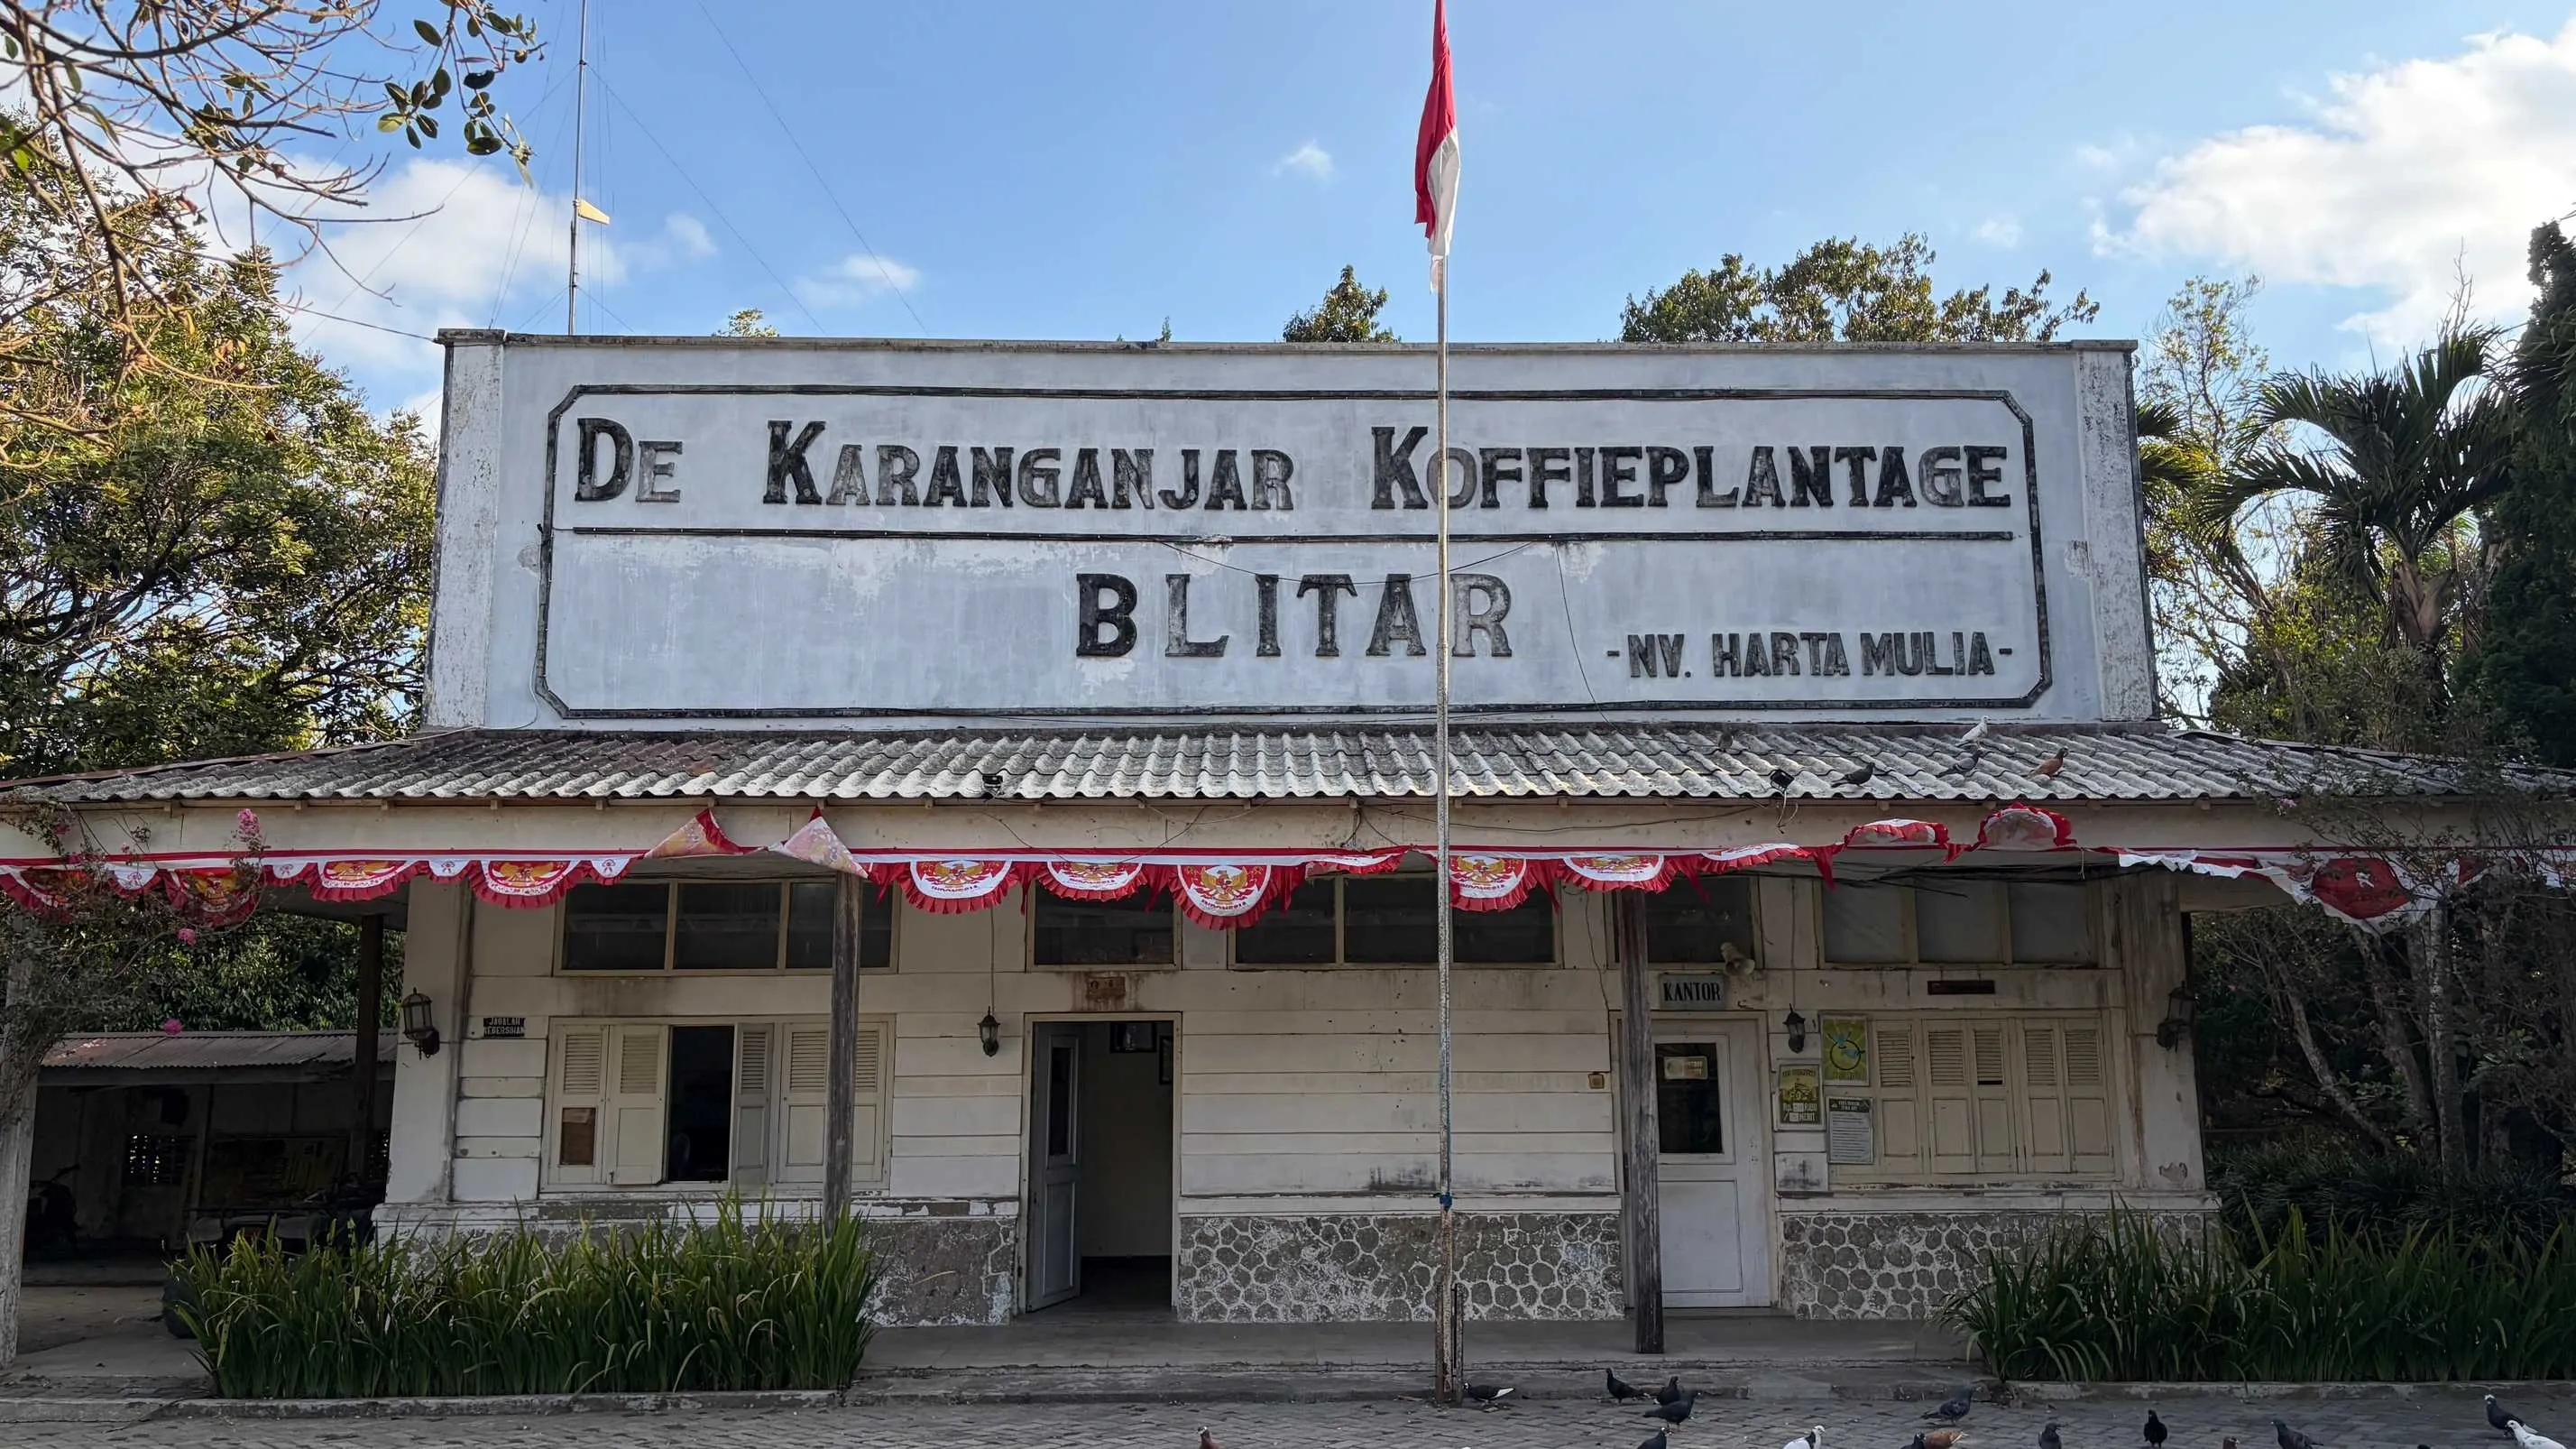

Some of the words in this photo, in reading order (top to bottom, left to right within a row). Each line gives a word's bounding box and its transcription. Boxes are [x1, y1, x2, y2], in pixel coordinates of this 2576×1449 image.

[575, 418, 683, 503] DE
[762, 420, 1294, 511] KARANGANJAR
[1370, 426, 2012, 511] KOFFIEPLANTAGE
[1076, 573, 1513, 658] BLITAR
[1713, 632, 1850, 678] HARTA
[1663, 982, 1721, 1001] KANTOR
